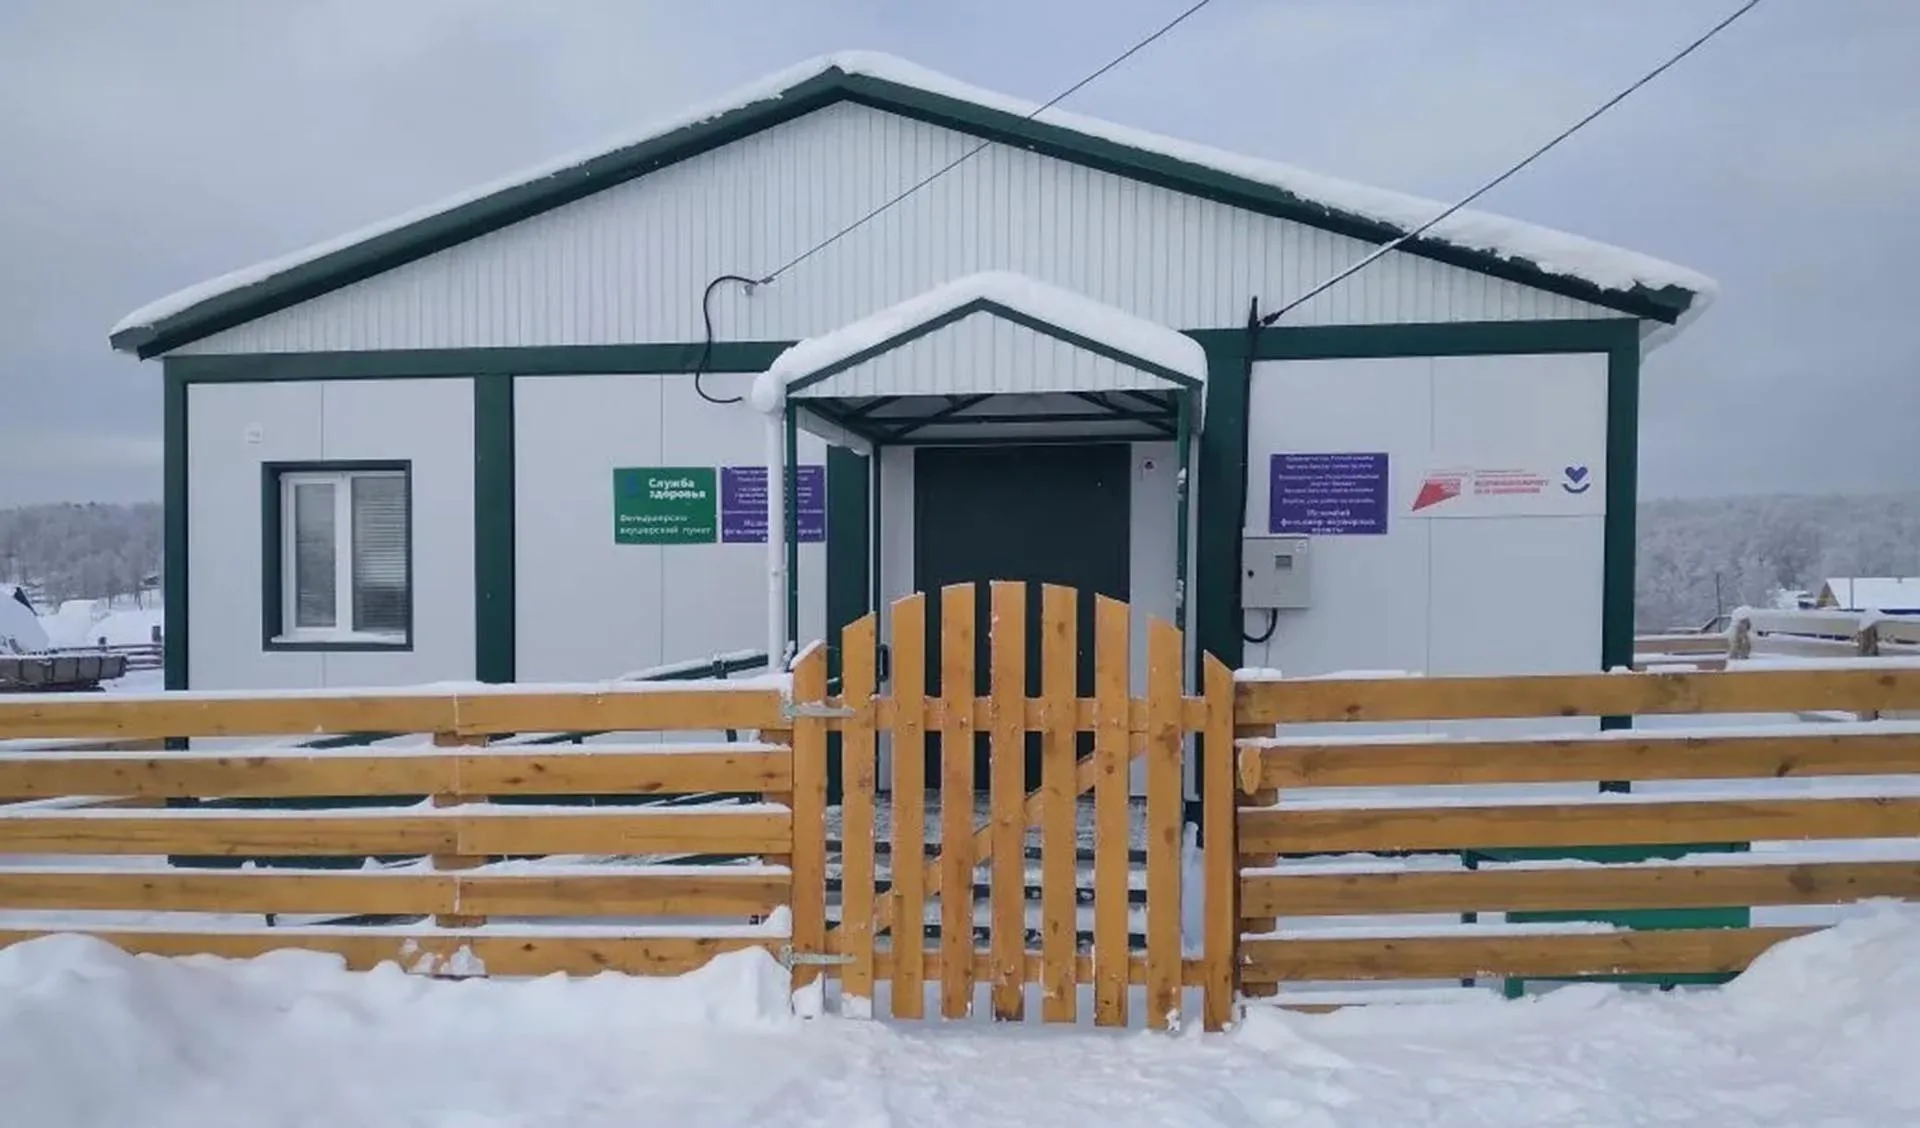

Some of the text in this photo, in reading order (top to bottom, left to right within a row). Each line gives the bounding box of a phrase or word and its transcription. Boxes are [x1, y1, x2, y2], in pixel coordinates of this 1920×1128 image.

[648, 477, 695, 490] Служба
[649, 490, 706, 500] здоровья
[683, 527, 711, 536] пункт
